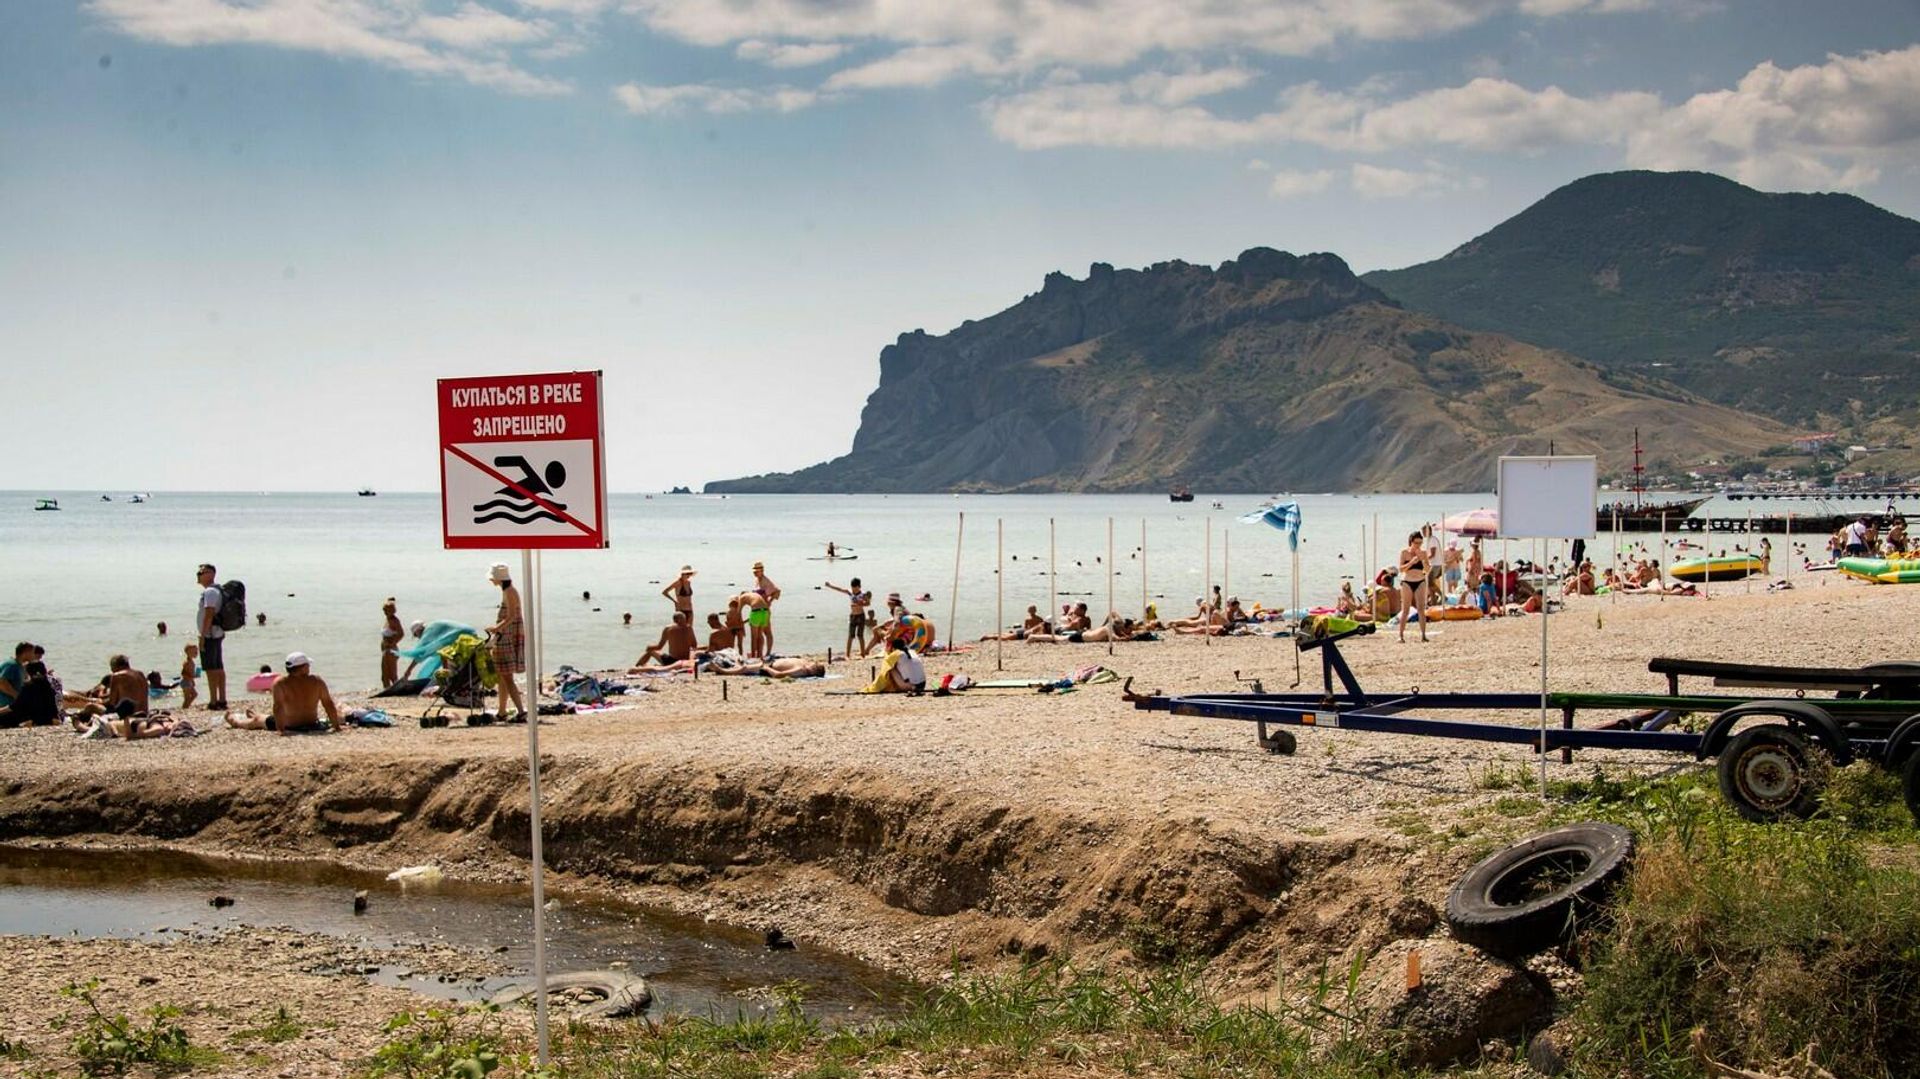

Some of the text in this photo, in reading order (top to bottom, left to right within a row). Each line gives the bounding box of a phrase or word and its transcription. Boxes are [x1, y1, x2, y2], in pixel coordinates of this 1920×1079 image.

[452, 383, 582, 407] КУПАТЬСЯ В РЕКЕ
[473, 414, 566, 437] ЗАПРЕЩЕНО
